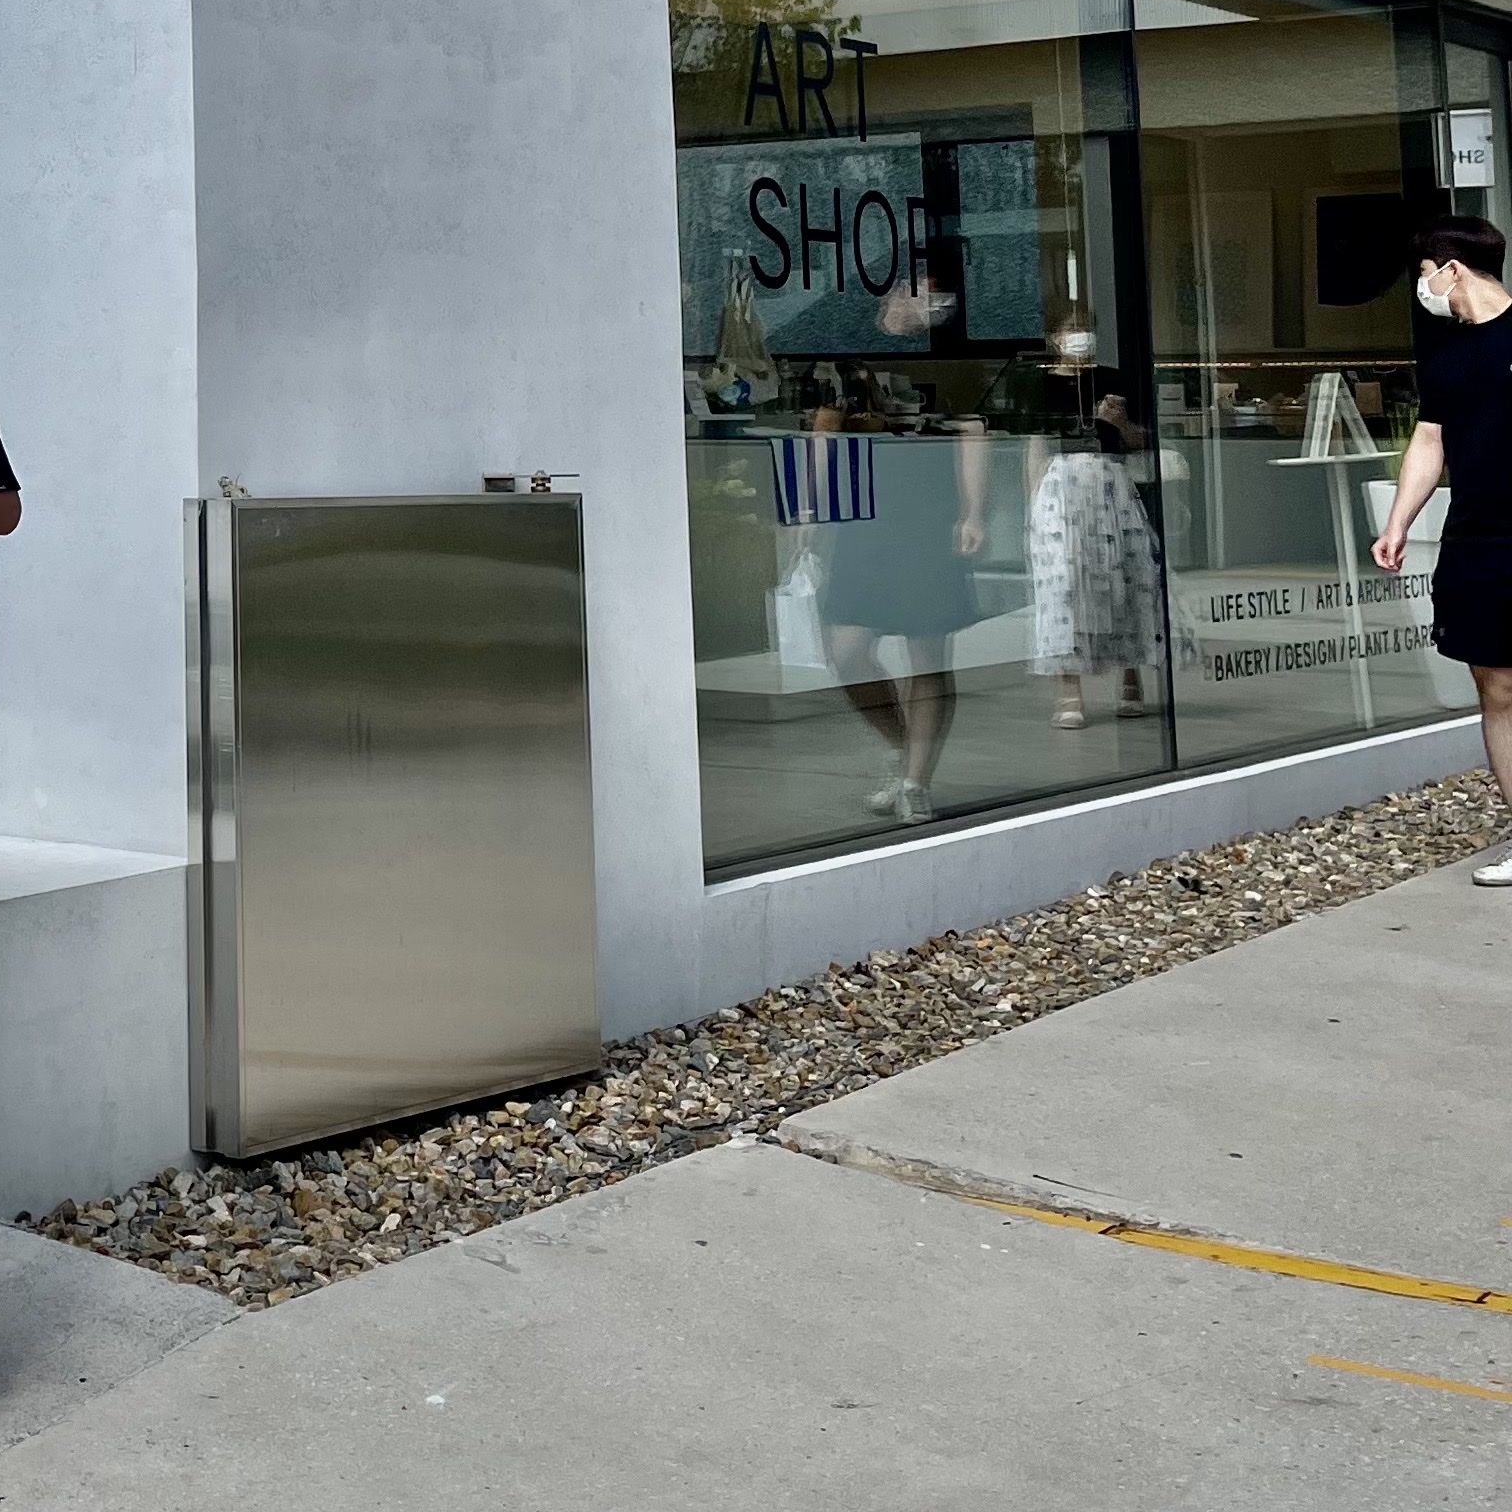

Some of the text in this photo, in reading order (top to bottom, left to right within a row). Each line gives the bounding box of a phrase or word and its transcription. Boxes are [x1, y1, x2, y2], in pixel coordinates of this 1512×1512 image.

[744, 21, 878, 143] ART
[749, 176, 942, 298] SHOP
[1211, 593, 1244, 622] LIFE
[1248, 589, 1290, 618] STYLE
[1316, 583, 1340, 610] ART
[1345, 582, 1353, 606] &
[1214, 646, 1271, 681] BAKERY
[1285, 638, 1337, 670] DESIGN
[1349, 630, 1388, 658] PLANT
[1393, 629, 1400, 653] &
